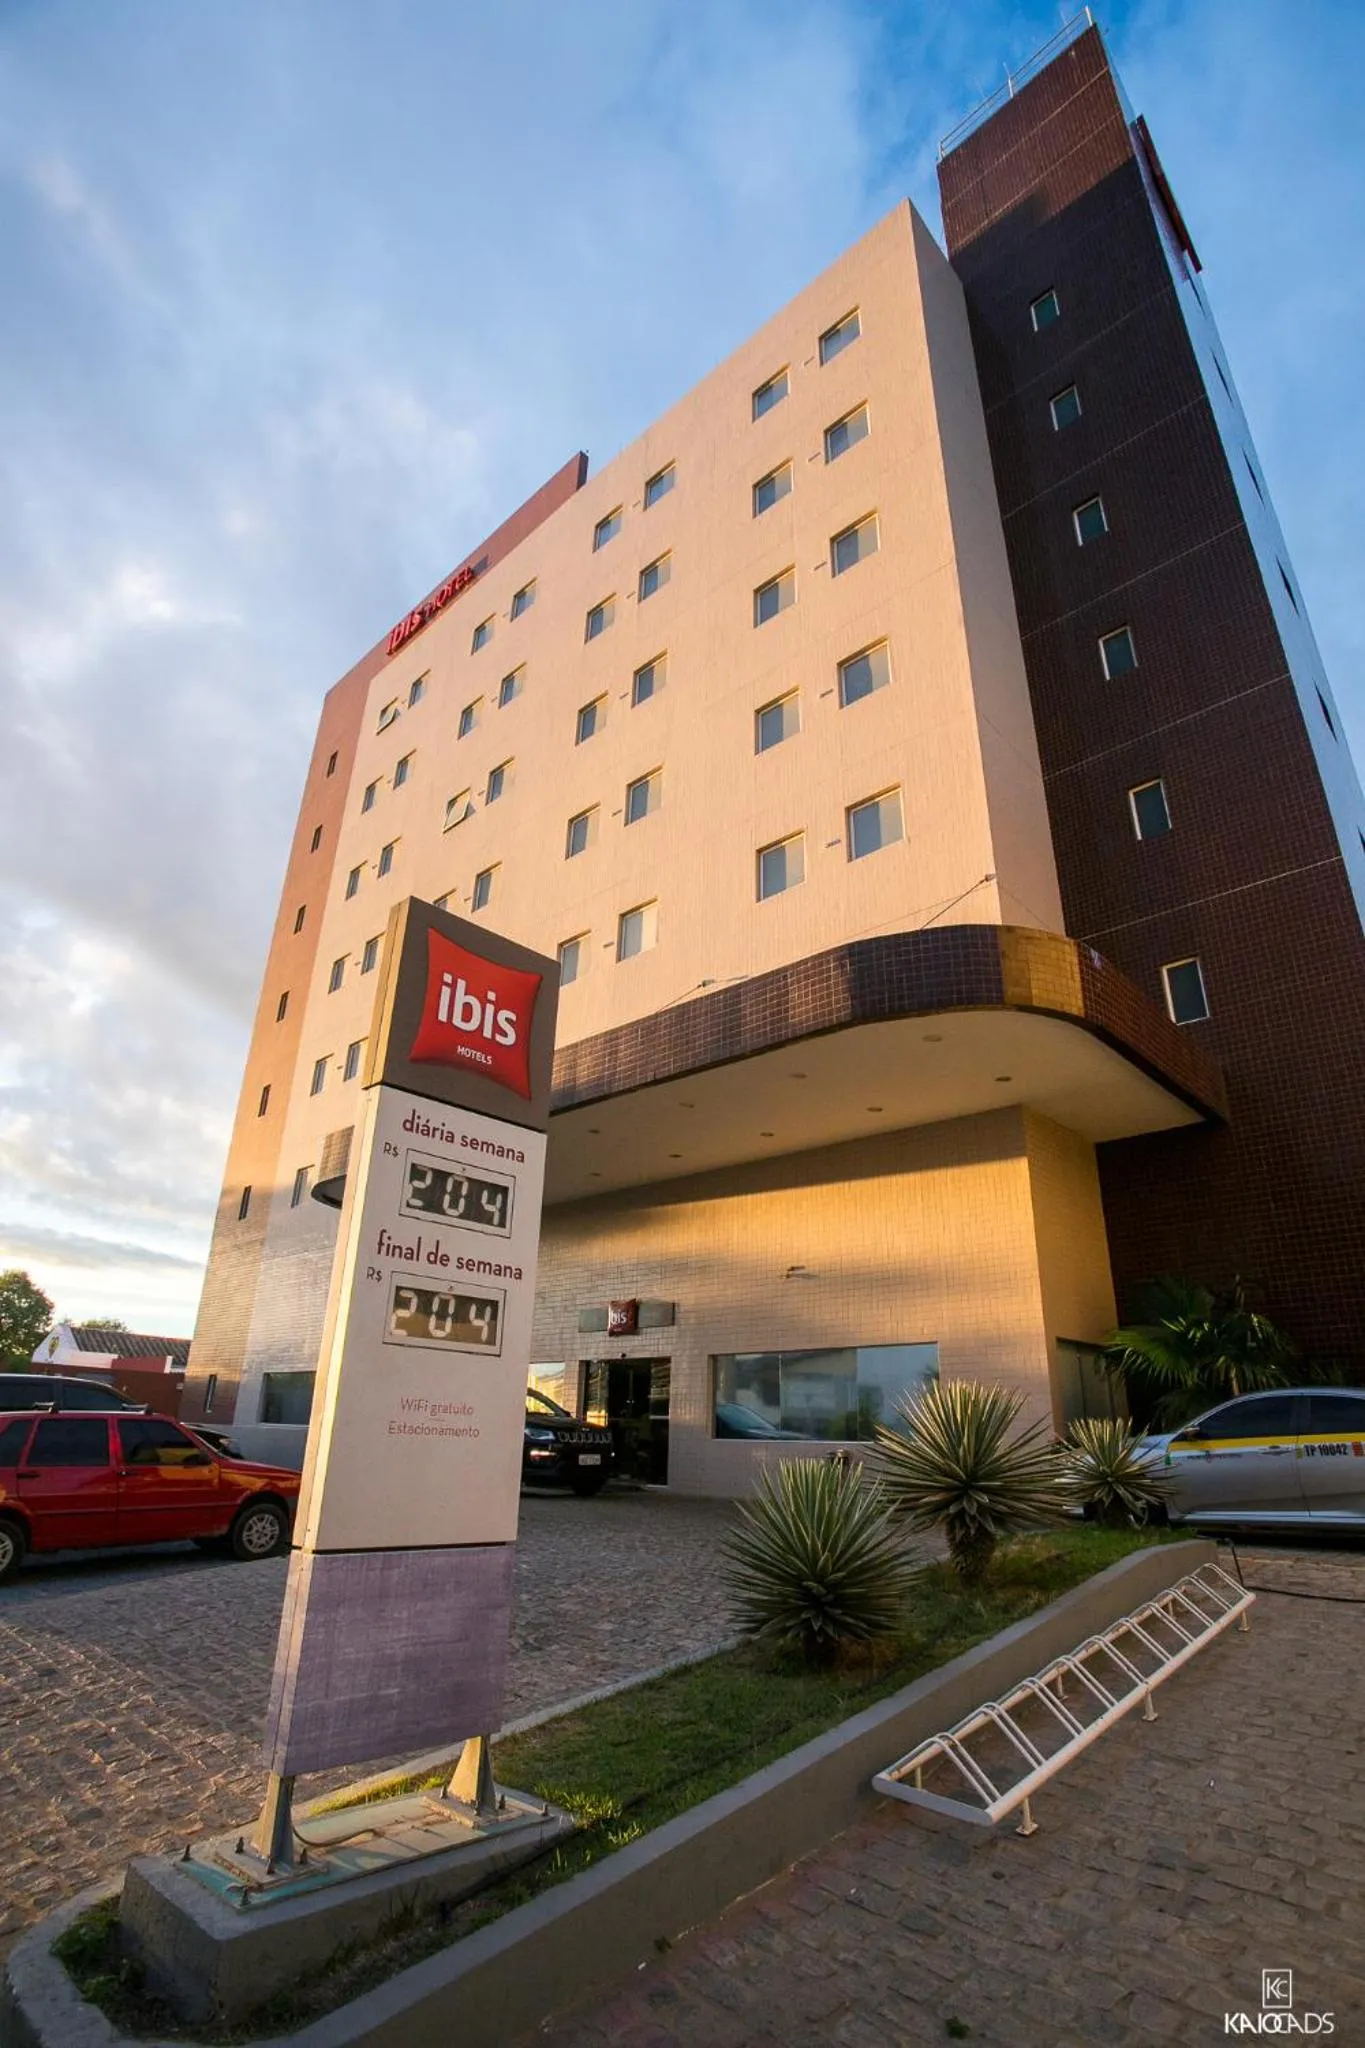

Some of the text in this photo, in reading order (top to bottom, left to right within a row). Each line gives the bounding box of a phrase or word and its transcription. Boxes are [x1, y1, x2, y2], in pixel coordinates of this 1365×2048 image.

[438, 971, 517, 1046] ibis
[457, 1045, 493, 1065] HOTELS
[383, 1142, 398, 1158] R$
[402, 1109, 525, 1163] diária semana
[406, 1165, 503, 1226] 204
[376, 1229, 523, 1280] final de semana
[366, 1266, 383, 1283] R$
[390, 1289, 492, 1342] 204
[430, 1404, 474, 1417] gratuito
[388, 1421, 480, 1438] Estacionamento
